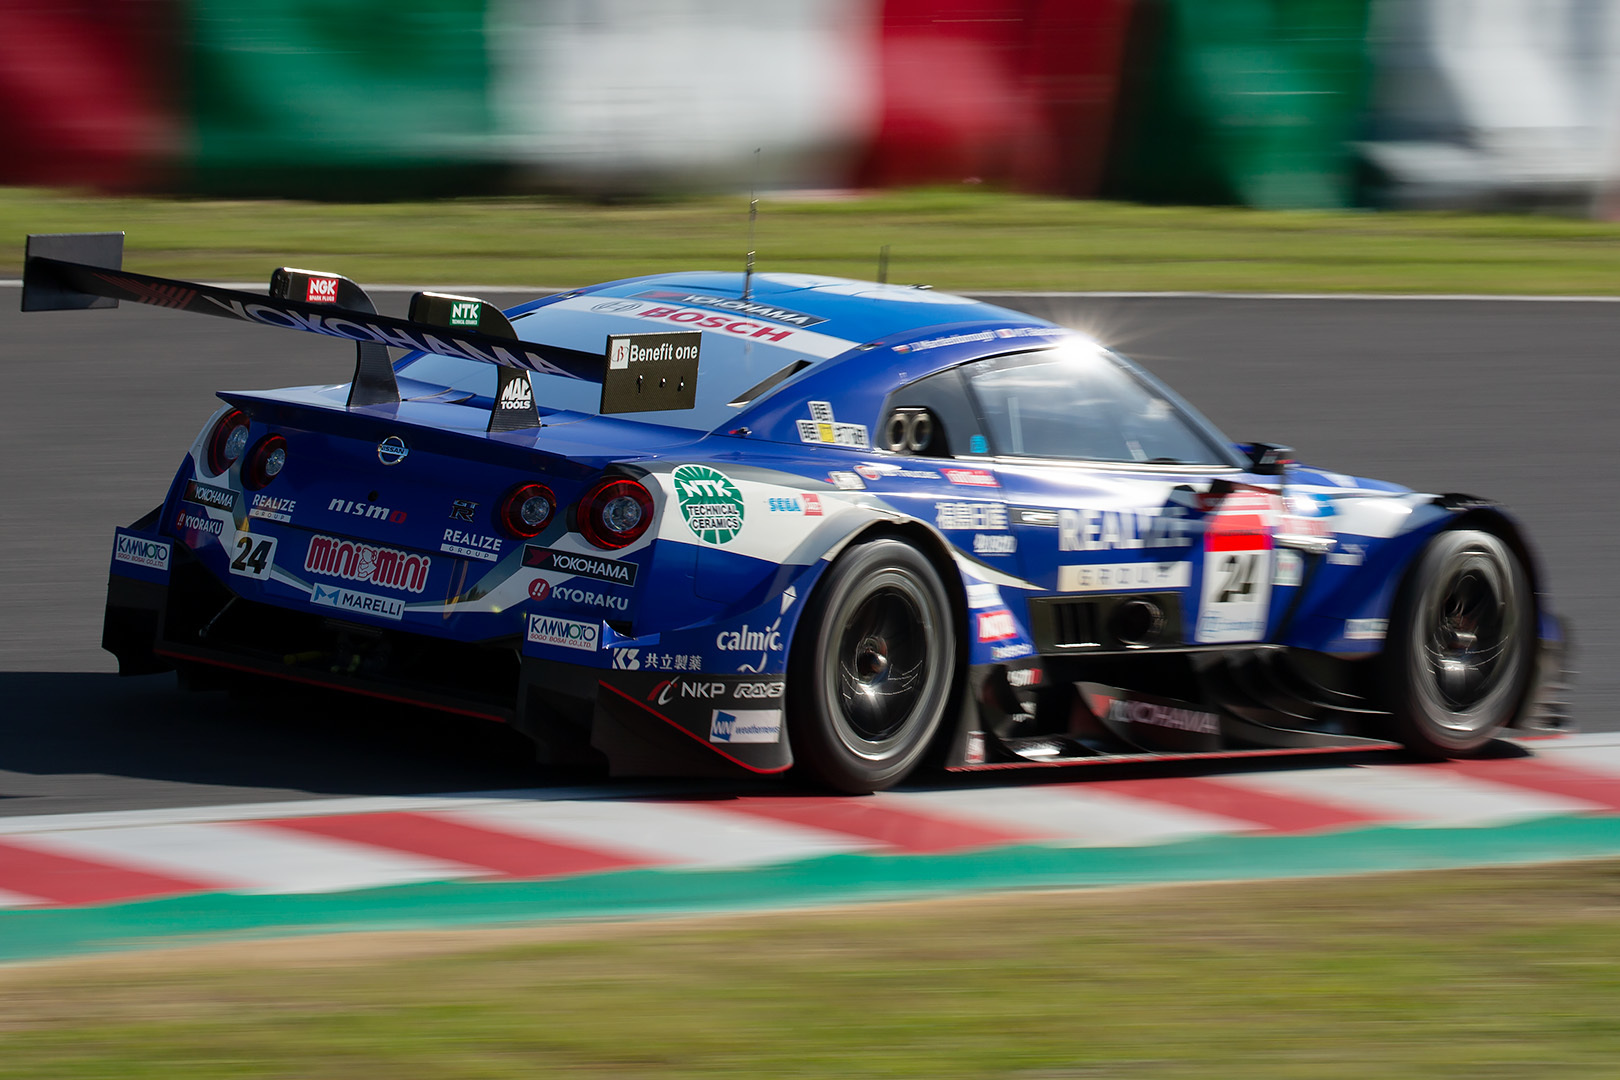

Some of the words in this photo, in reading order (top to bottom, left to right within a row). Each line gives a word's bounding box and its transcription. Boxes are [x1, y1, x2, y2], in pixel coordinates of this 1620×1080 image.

[309, 279, 337, 295] NGK
[452, 303, 480, 319] NTK
[682, 294, 810, 325] YOKOHAMA
[637, 307, 794, 342] BOSCH
[629, 343, 673, 362] Benefit
[675, 344, 698, 361] one
[501, 400, 531, 410] TOOLS
[194, 486, 233, 508] YOKOHAMA
[679, 479, 733, 498] NTK
[252, 493, 297, 512] REALIZE
[688, 504, 739, 516] TECHNICAL
[768, 497, 803, 512] SEGA
[185, 515, 223, 535] KYORAKU
[254, 510, 286, 521] GROUP
[692, 517, 739, 529] CERAMICS
[443, 528, 503, 551] REALIZE
[231, 537, 273, 575] 24
[448, 546, 490, 559] GROUP
[552, 554, 629, 581] YOKOHAMA
[342, 593, 402, 616] MARELLI
[552, 586, 629, 611] KYORAKU
[716, 624, 782, 651] calmic
[612, 647, 641, 671] KS
[644, 652, 702, 671] 共立製薬
[681, 681, 726, 698] NKP
[733, 681, 786, 699] RAYS
